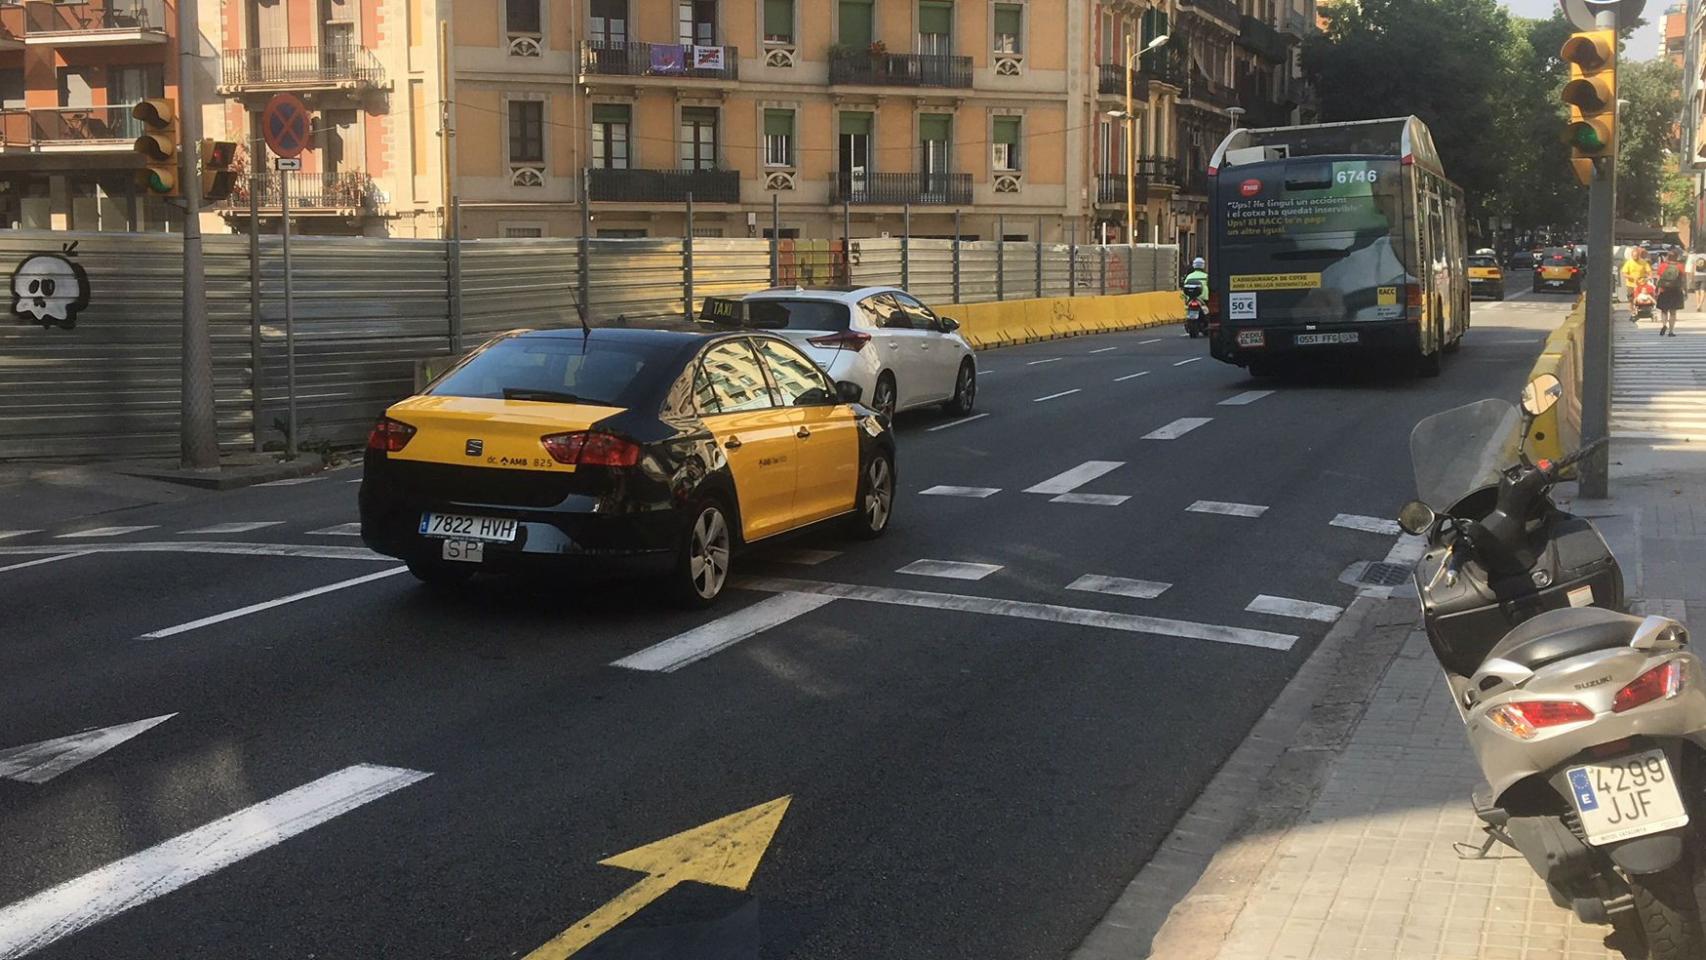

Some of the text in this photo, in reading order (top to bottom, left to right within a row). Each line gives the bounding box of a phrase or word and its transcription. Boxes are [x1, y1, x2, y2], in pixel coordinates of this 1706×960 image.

[1336, 169, 1377, 183] 6746
[1253, 200, 1265, 208] He
[1232, 209, 1241, 218] el
[1242, 209, 1266, 217] cotxe
[1267, 208, 1279, 216] ha
[1281, 206, 1313, 217] quedat
[1258, 216, 1282, 225] RACC
[1240, 226, 1262, 235] altre
[713, 301, 733, 317] TAXI
[1231, 301, 1254, 310] 50 €
[1299, 335, 1319, 344] 0551
[509, 457, 528, 466] AMB
[533, 458, 553, 468] 825
[432, 515, 473, 534] 7822
[480, 520, 514, 538] HVH
[447, 540, 479, 559] SP
[1574, 675, 1613, 690] SUZUKI
[1596, 756, 1665, 794] 4299
[1581, 793, 1592, 805] E
[1607, 788, 1652, 824] JJF
